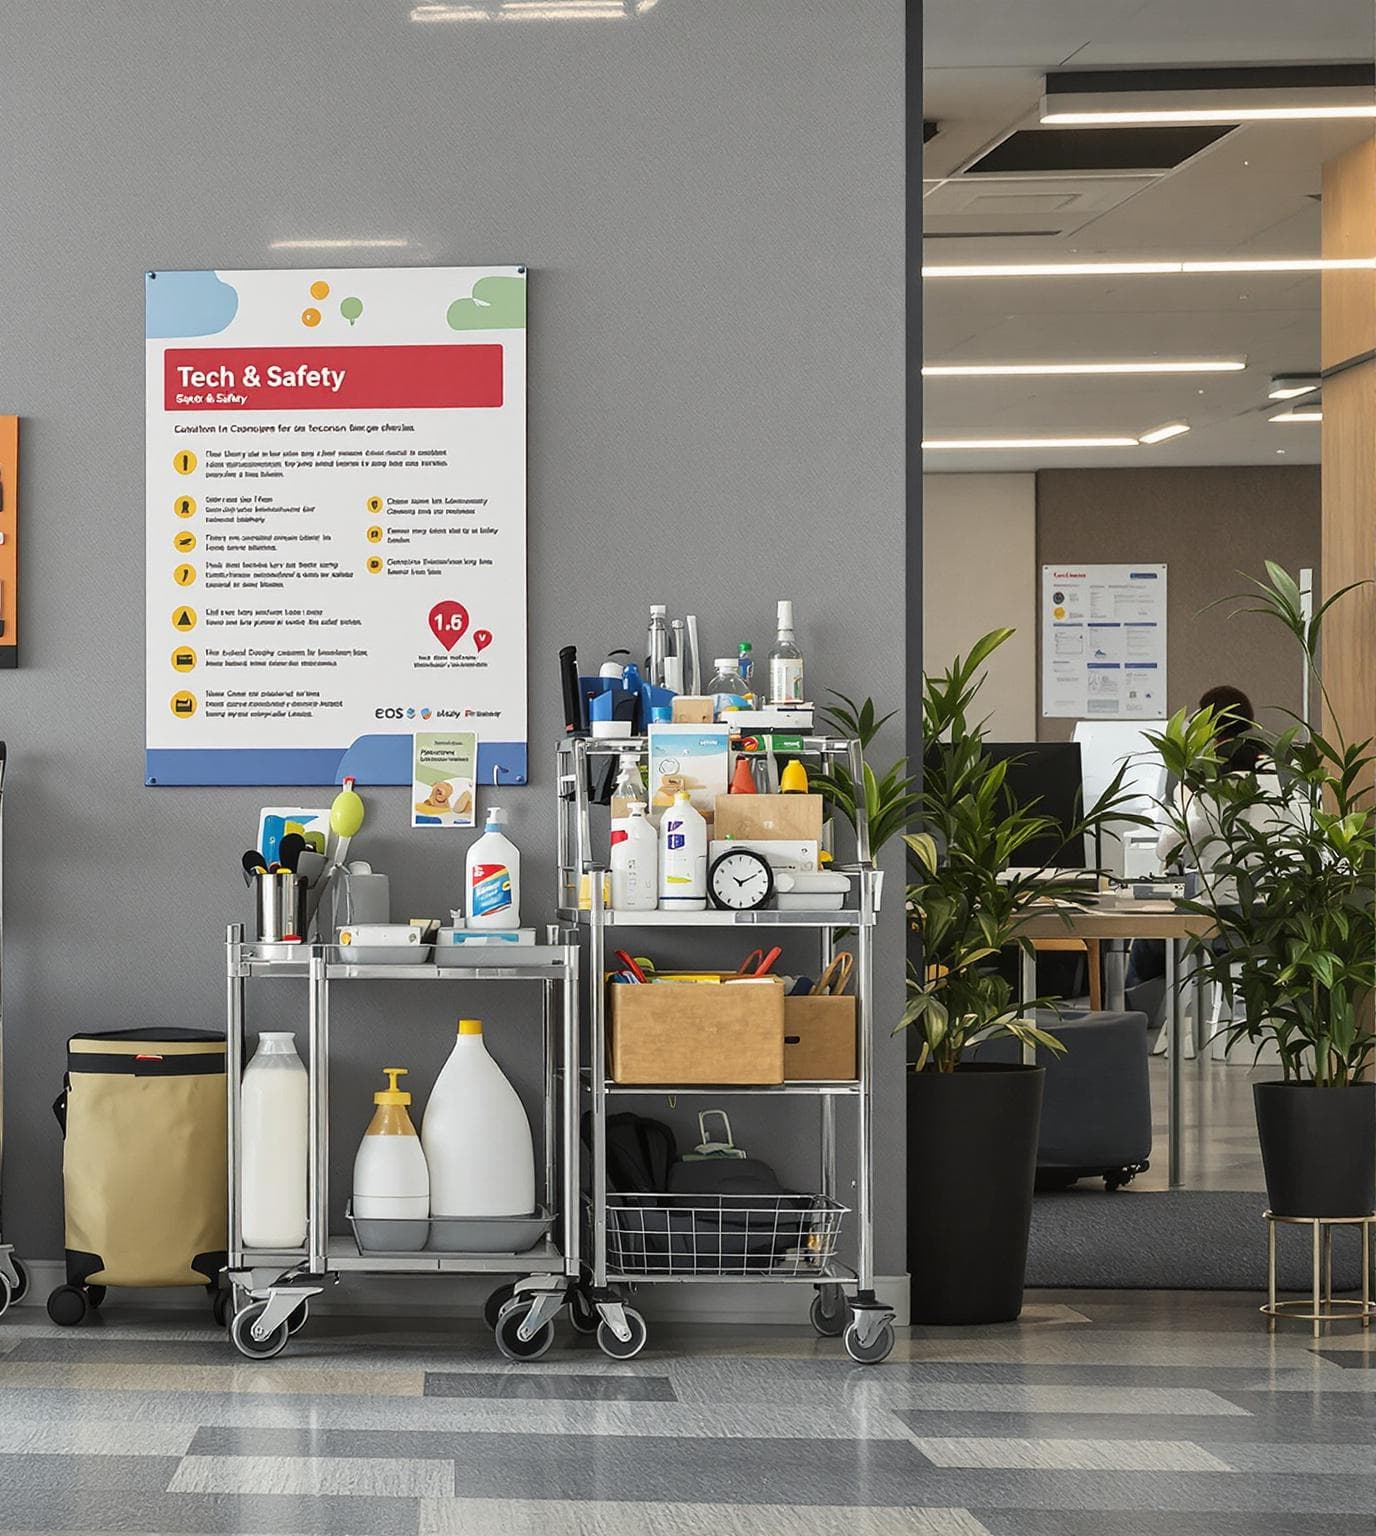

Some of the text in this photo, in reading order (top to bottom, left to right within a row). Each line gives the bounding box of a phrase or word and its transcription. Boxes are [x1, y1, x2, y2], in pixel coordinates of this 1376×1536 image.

[176, 364, 346, 392] Tech & Safety
[434, 613, 463, 631] 1.6
